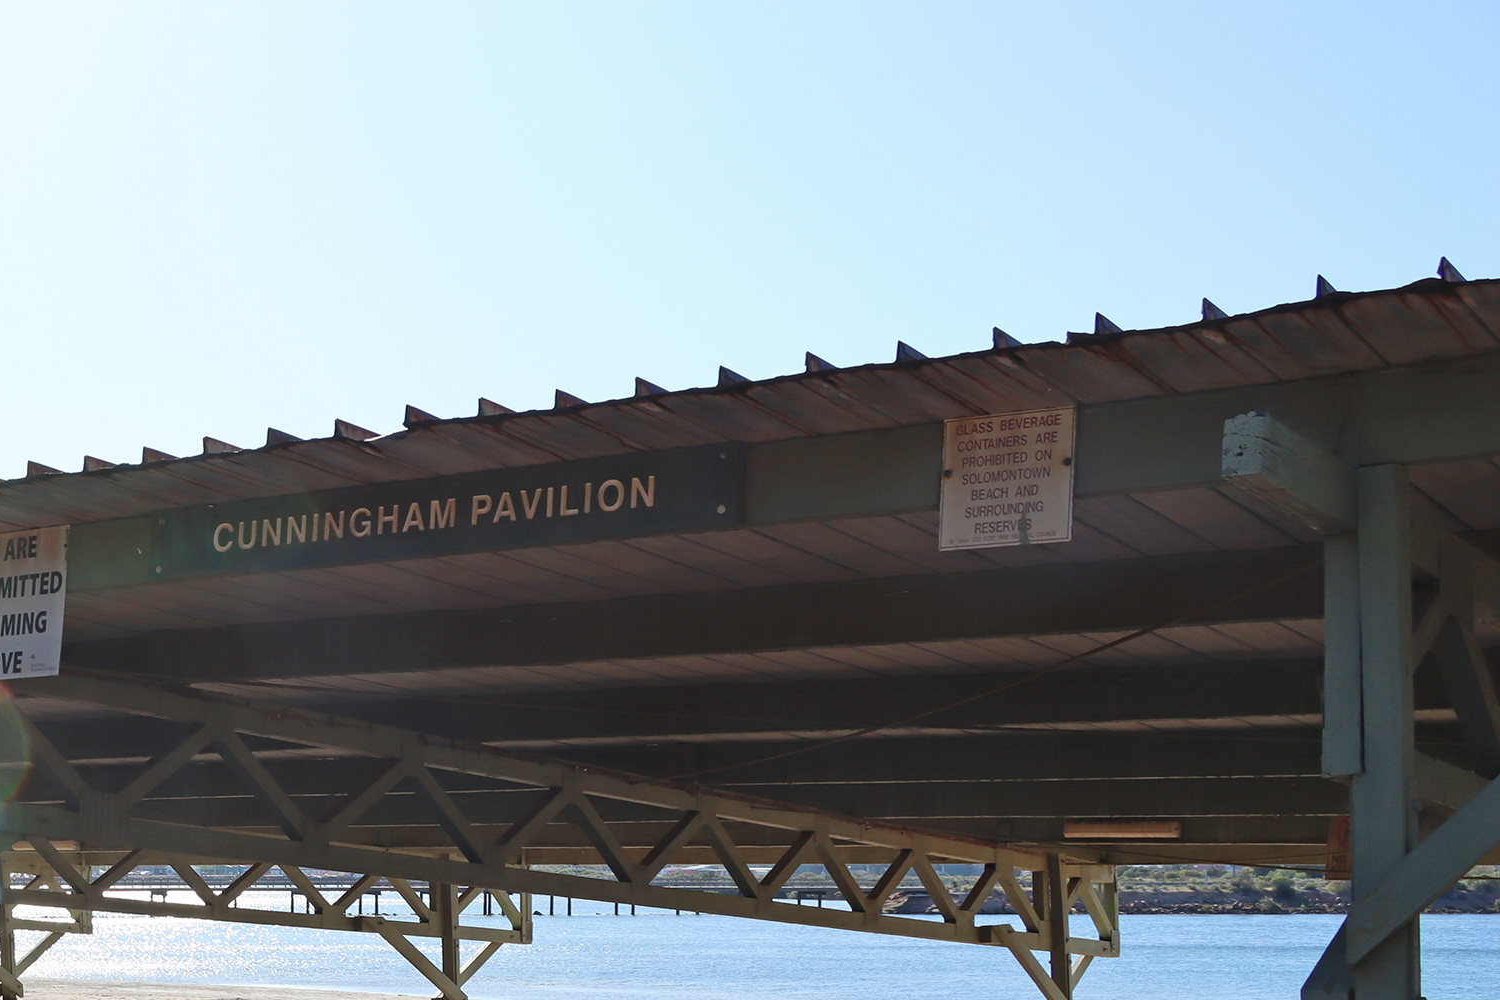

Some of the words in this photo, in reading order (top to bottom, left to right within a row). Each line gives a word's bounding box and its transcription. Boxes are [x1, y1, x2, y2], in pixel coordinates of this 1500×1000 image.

[956, 421, 994, 436] GLASS
[1000, 414, 1062, 432] BEVERAGE
[957, 435, 1028, 453] CONTAINERS
[1035, 431, 1059, 445] ARE
[961, 452, 1028, 469] PROHIBITED
[1035, 449, 1053, 462] ON
[961, 466, 1051, 486] SOLOMONTOWN
[971, 487, 1009, 501] BEACH
[1015, 484, 1039, 497] AND
[212, 499, 457, 553] CUNNINGHAM
[470, 475, 657, 526] PAVILION
[964, 501, 1044, 519] SURROUNDING
[3, 535, 38, 561] ARE
